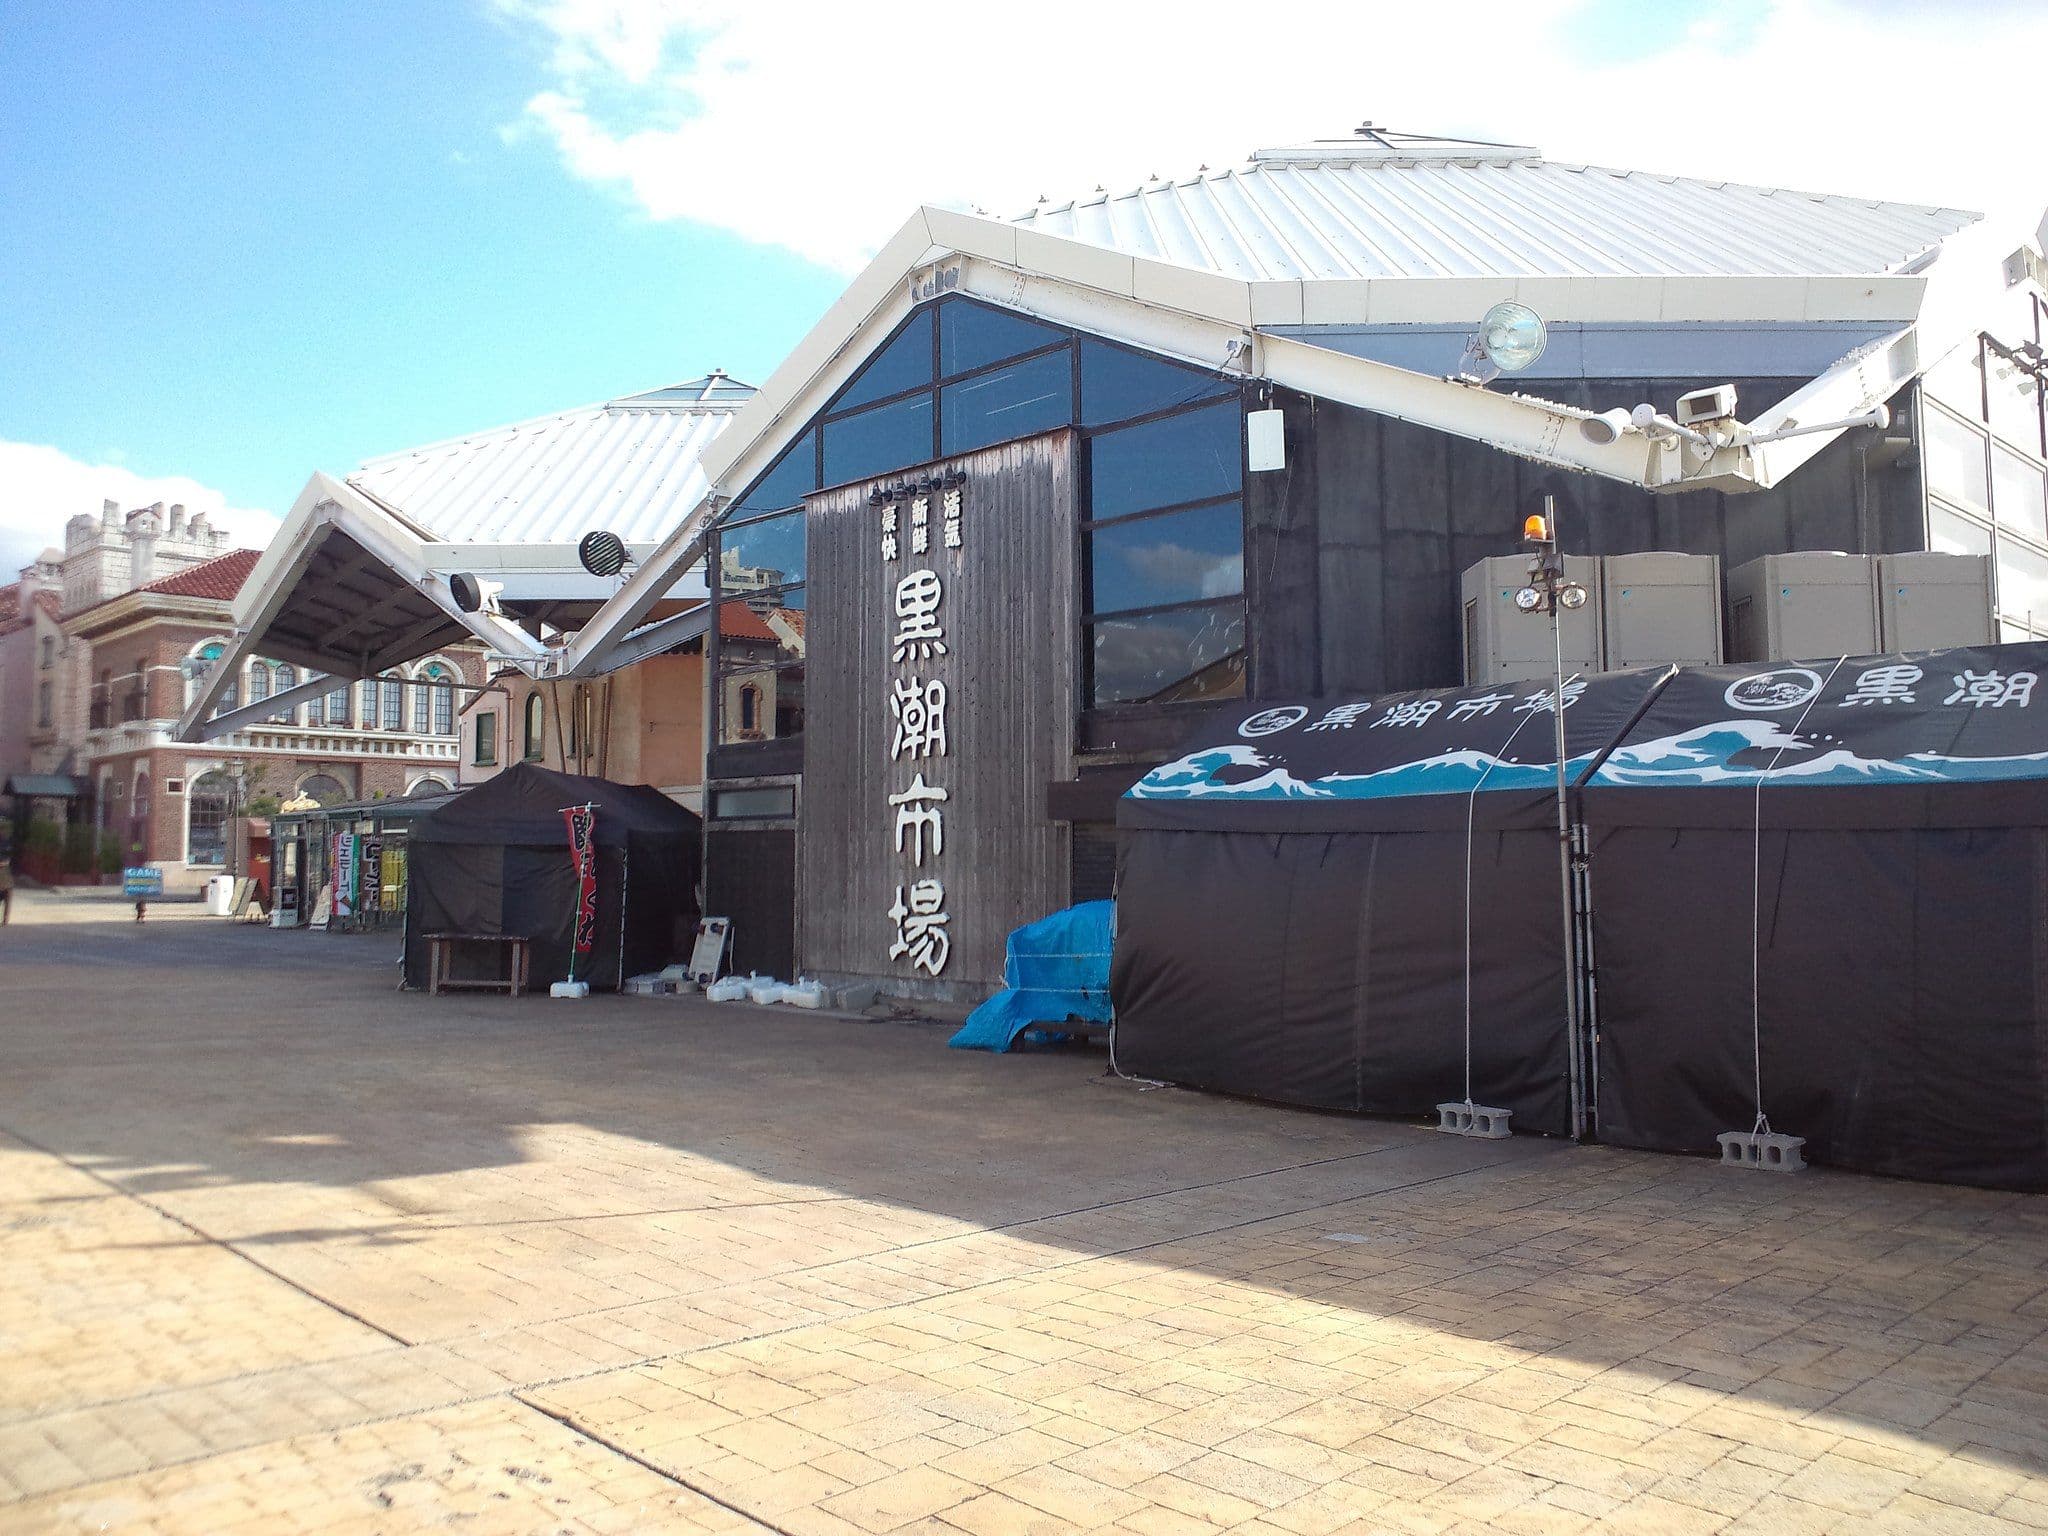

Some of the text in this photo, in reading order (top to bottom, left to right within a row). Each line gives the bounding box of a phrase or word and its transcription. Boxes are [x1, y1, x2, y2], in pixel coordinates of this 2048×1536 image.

[881, 505, 897, 561] 豪快
[911, 498, 929, 554] 新鮮
[943, 490, 961, 548] 活気
[1303, 681, 1589, 734] 黒潮市場
[1838, 664, 2039, 709] 黒潮
[888, 569, 951, 977] 黒潮市場
